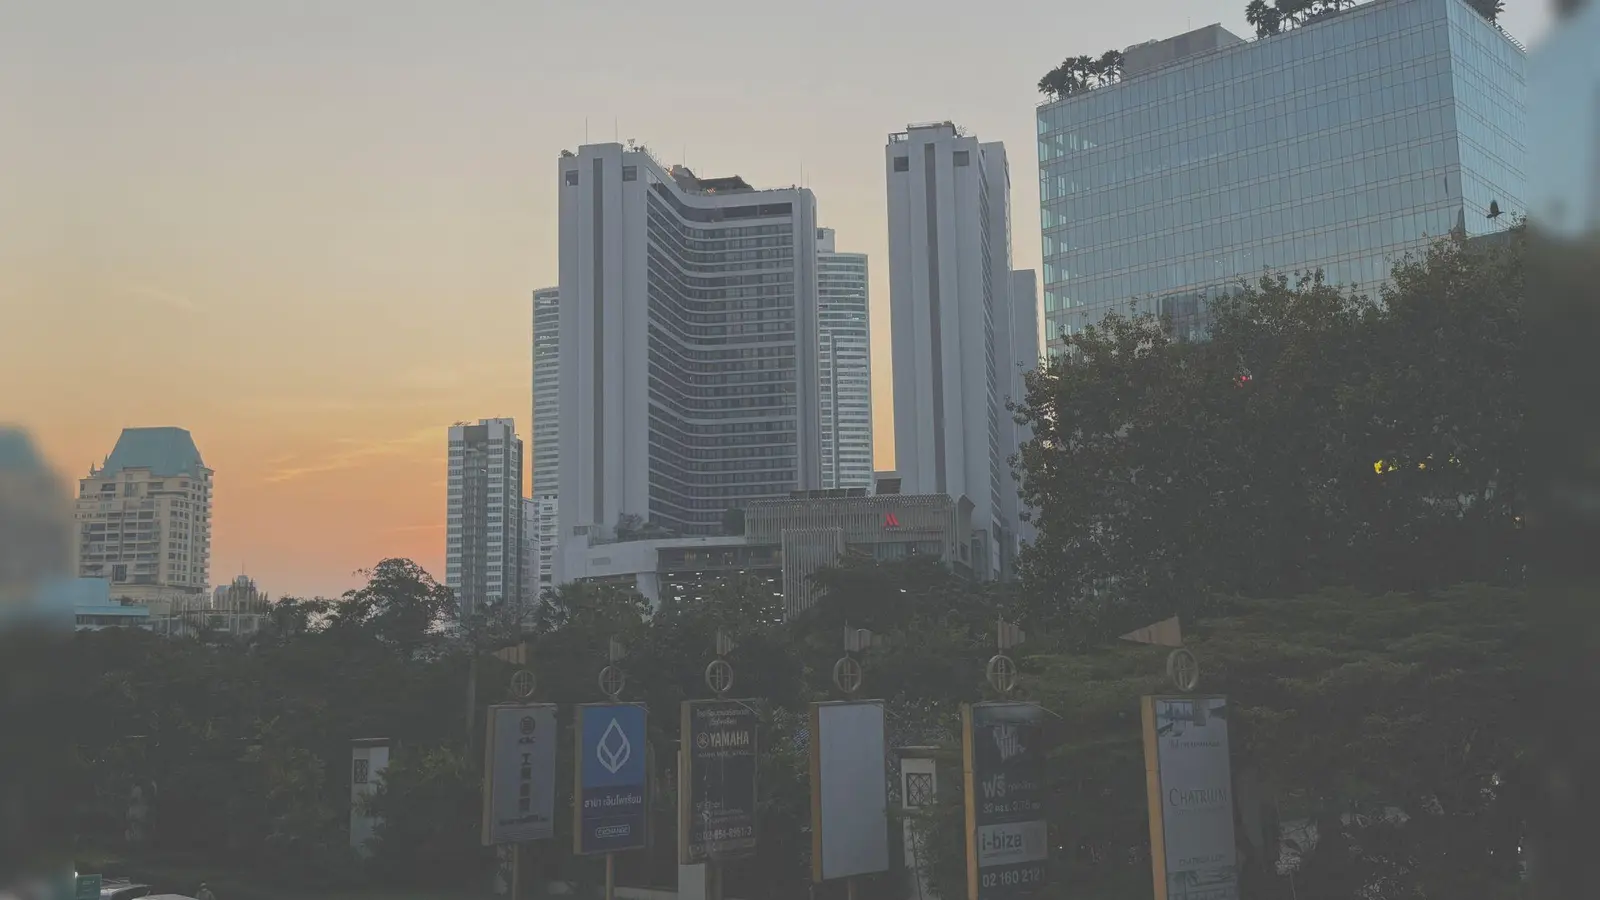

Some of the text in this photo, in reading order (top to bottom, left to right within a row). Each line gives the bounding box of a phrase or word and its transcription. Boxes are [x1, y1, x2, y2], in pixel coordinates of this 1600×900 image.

[709, 730, 749, 747] YAMAHA
[982, 873, 997, 888] 02
[999, 870, 1019, 886] 160
